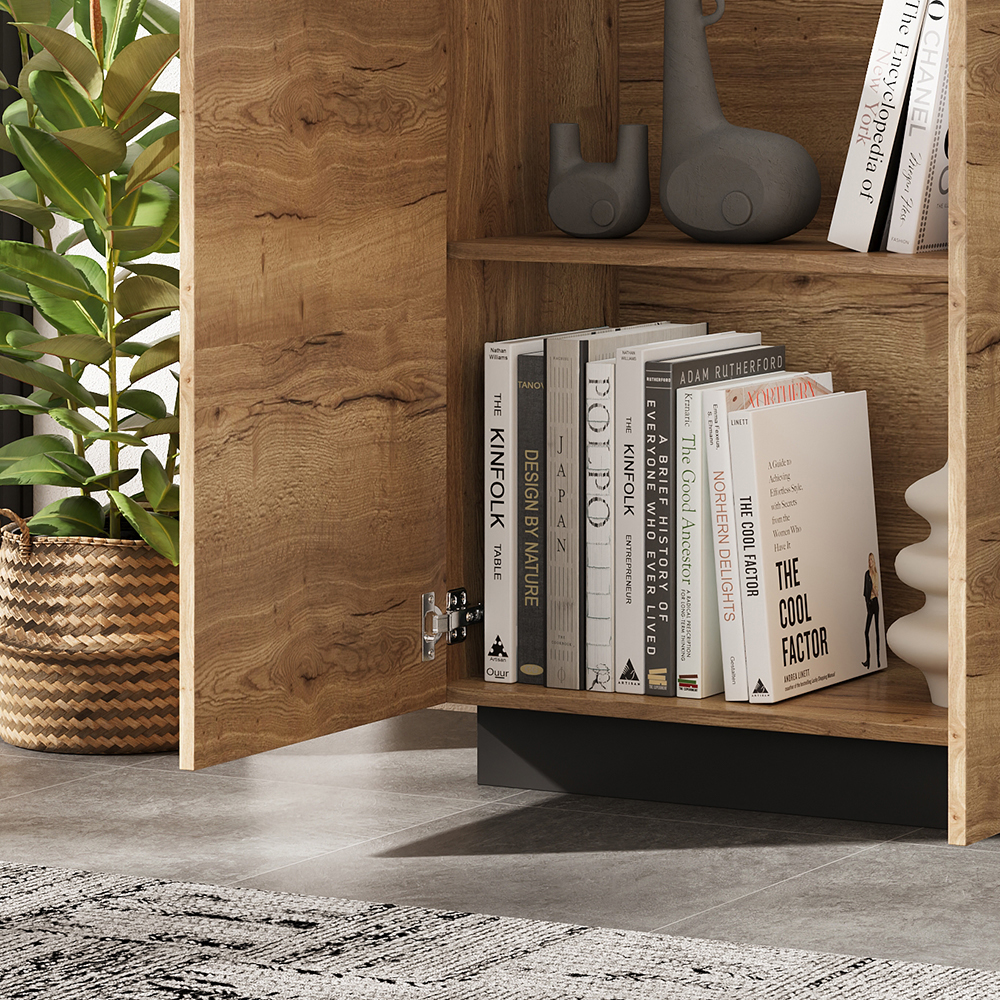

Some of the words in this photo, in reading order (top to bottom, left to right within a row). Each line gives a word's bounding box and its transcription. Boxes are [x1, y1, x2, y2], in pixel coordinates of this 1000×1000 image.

[898, 0, 921, 35] The
[868, 48, 891, 93] New
[908, 30, 941, 137] CHANEL
[855, 101, 880, 146] York
[866, 42, 910, 173] Encyclopedia
[858, 183, 874, 204] of
[679, 366, 709, 385] ADAM
[715, 355, 783, 379] RUTHERFORD
[493, 393, 502, 416] THE
[730, 418, 748, 426] LINETT
[646, 400, 656, 491] EVERYONE
[658, 434, 669, 444] A
[681, 434, 697, 464] The
[490, 428, 505, 528] KINFOLK
[524, 449, 539, 511] DESIGN
[623, 444, 635, 516] KINFOLK
[658, 455, 669, 506] BRIEF
[769, 473, 791, 483] Achieving
[772, 459, 787, 469] Guide
[556, 435, 566, 552] JAPAN
[681, 469, 697, 512] Good
[713, 471, 730, 544] NORHERN
[740, 496, 753, 517] THE
[769, 486, 791, 497] Effortless
[524, 516, 539, 538] BY
[646, 502, 656, 540] WHO
[741, 522, 756, 551] COOL
[772, 528, 791, 538] Women
[493, 543, 502, 580] TABLE
[658, 516, 669, 591] HISTORY
[681, 516, 696, 585] Ancestor
[524, 542, 539, 607] NATURE
[646, 551, 656, 594] EVER
[719, 549, 736, 622] DELIGHTS
[744, 554, 759, 597] FACTOR
[775, 557, 801, 591] THE
[658, 601, 669, 622] OF
[779, 593, 812, 629] COOL
[646, 605, 656, 656] LIVED
[781, 626, 829, 667] FACTOR
[486, 667, 509, 678] Ouur
[783, 672, 798, 683] ANDREA
[797, 668, 810, 679] LINETT
